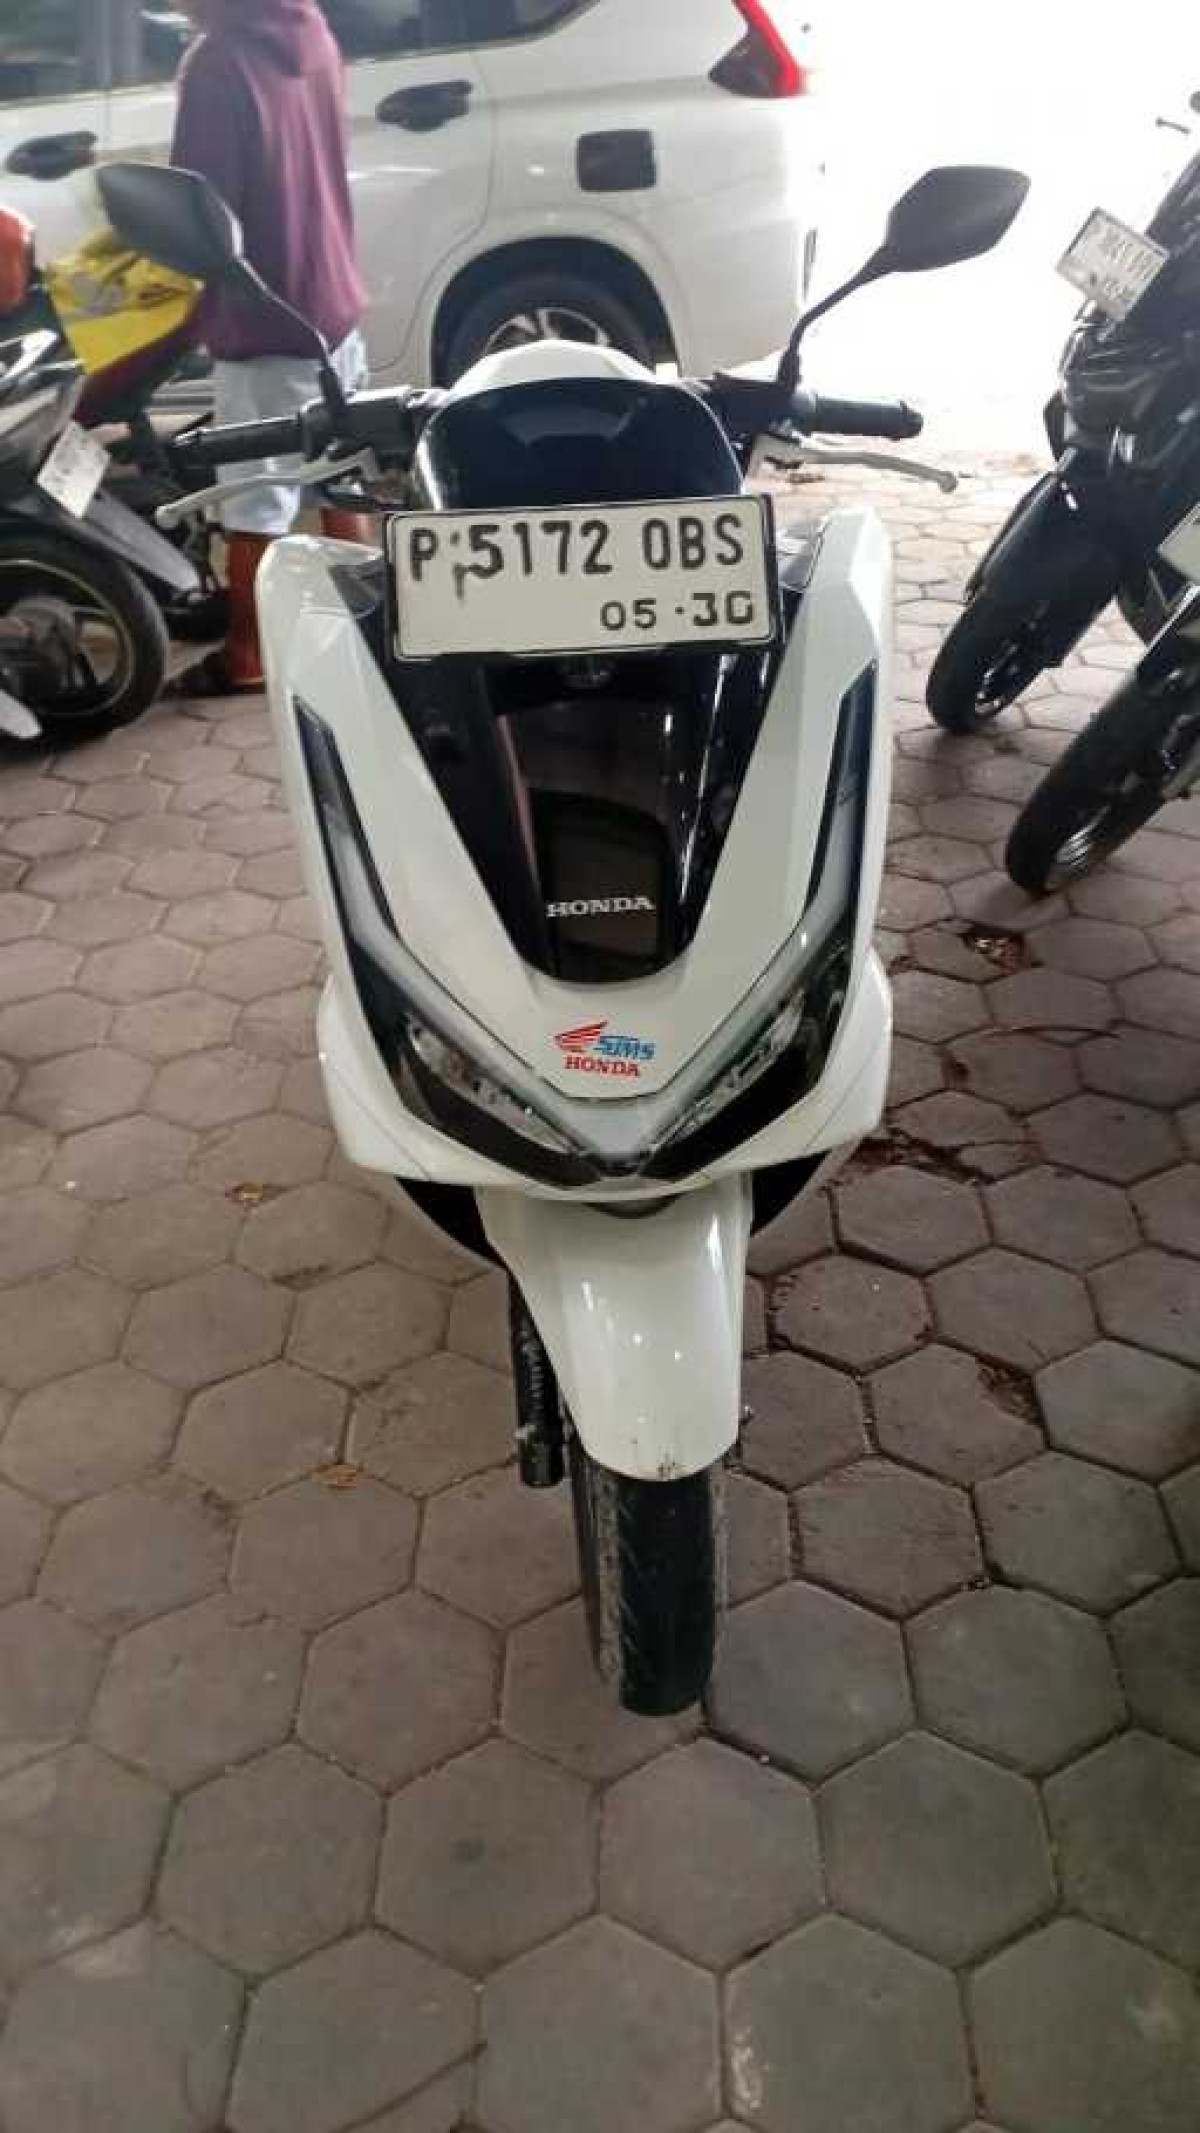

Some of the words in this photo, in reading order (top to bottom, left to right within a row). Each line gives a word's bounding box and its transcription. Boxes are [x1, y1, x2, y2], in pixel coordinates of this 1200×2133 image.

[409, 527, 439, 582] P
[468, 518, 614, 580] 5172
[546, 896, 656, 918] HONDA
[564, 1056, 639, 1077] HONDA
